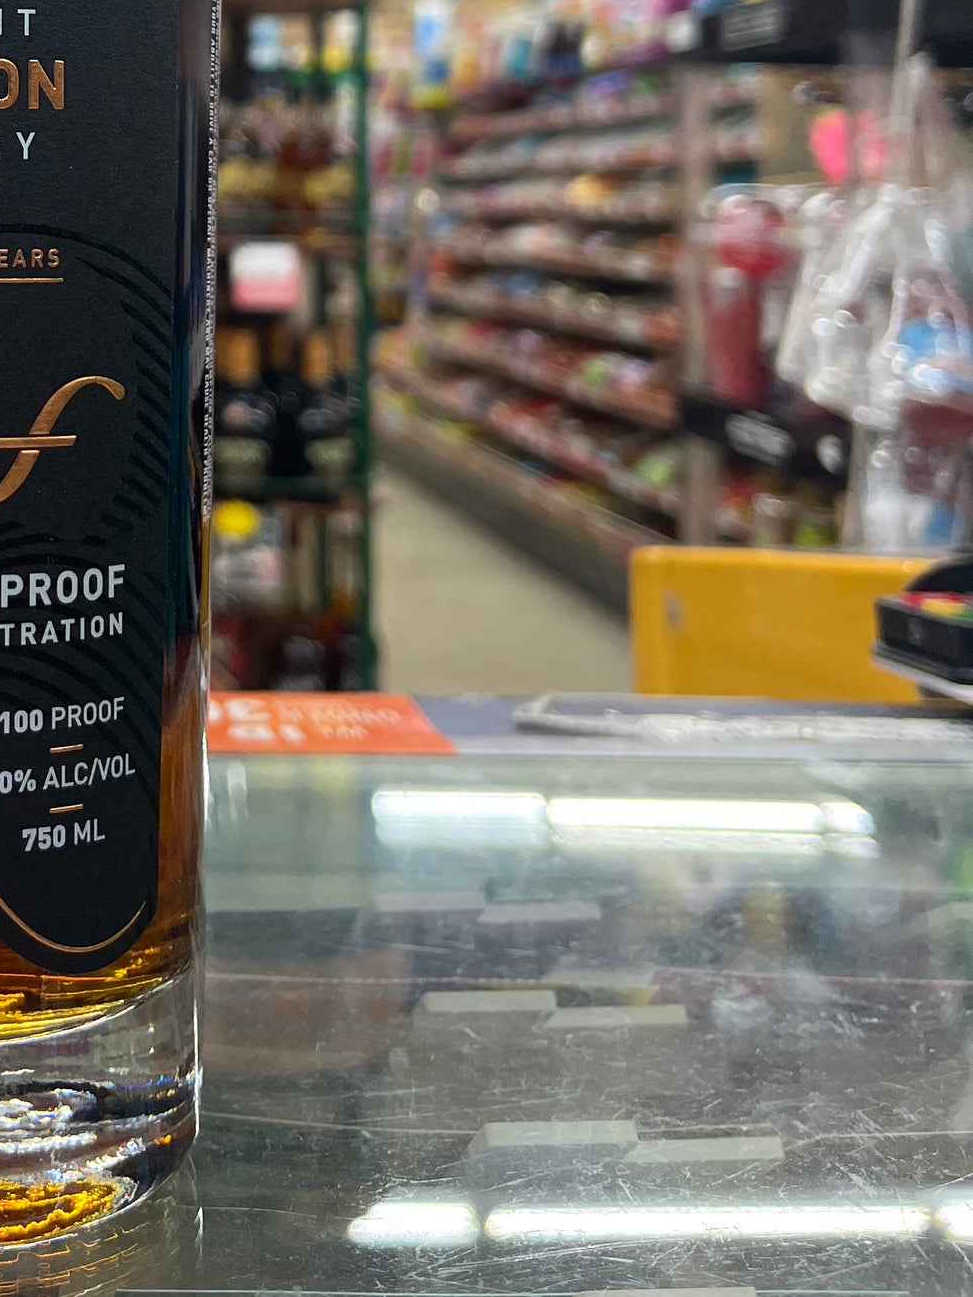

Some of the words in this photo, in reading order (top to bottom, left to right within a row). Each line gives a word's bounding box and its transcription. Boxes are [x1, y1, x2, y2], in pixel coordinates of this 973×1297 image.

[0, 563, 126, 609] PROOF
[0, 708, 44, 734] 100
[50, 696, 126, 730] PROOF
[42, 752, 137, 791] ALC/VOL
[21, 823, 67, 852] 750
[73, 817, 107, 846] ML
